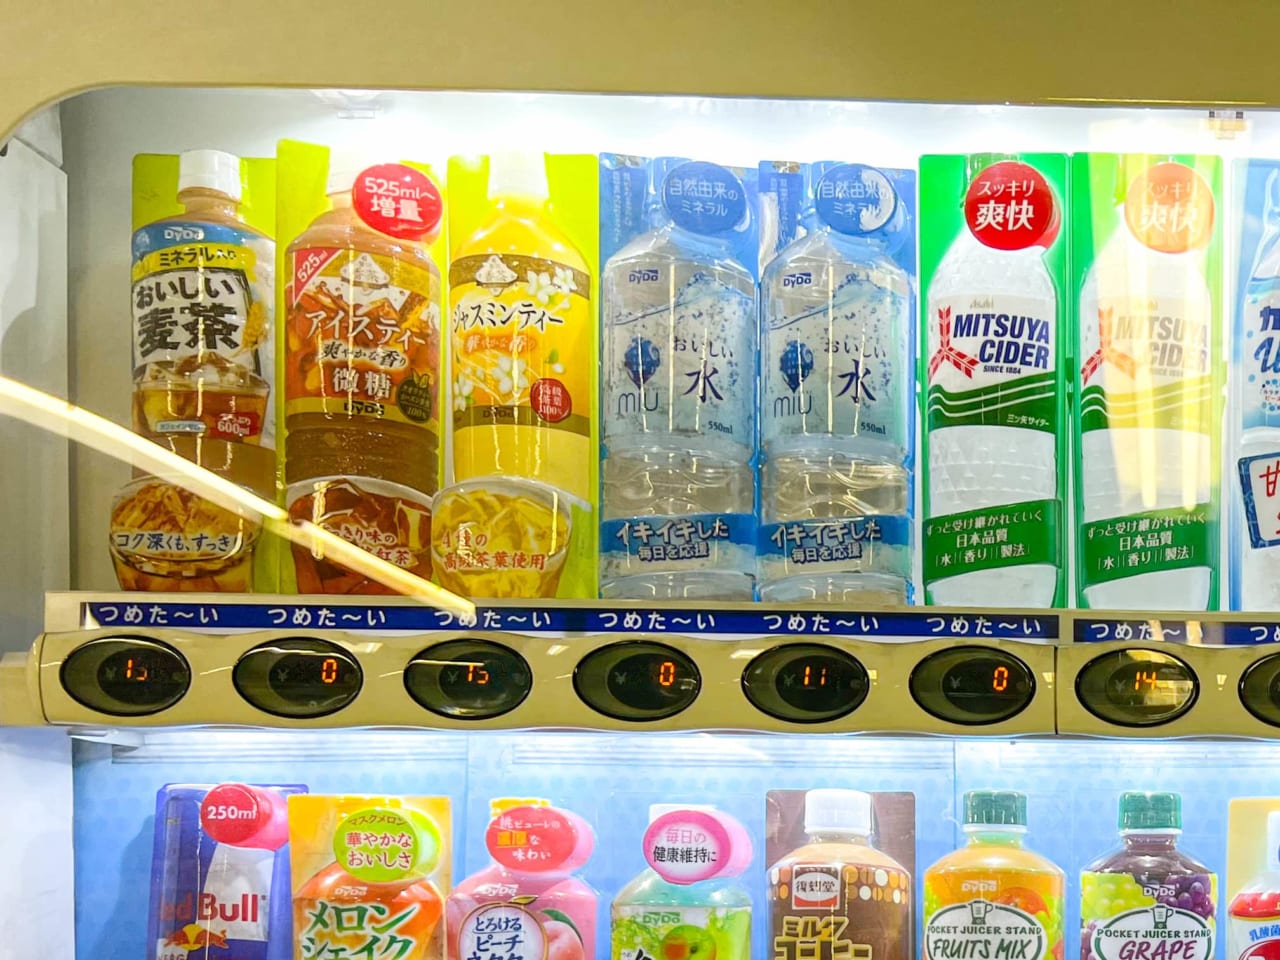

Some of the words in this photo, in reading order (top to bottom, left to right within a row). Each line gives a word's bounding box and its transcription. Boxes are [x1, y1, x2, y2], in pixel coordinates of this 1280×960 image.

[669, 178, 738, 202] 自然由来の
[978, 180, 1035, 196] スッキリ
[681, 203, 728, 217] ミネラル
[975, 202, 1035, 232] 爽快
[628, 269, 658, 285] DyDo
[136, 275, 235, 306] おいしい
[137, 304, 240, 357] 麦茶
[305, 310, 426, 349] アイスティー
[954, 313, 1049, 344] MITSUYA
[979, 340, 1049, 369] CIDER
[684, 359, 724, 403] 水
[708, 421, 733, 435] 550ml
[616, 518, 729, 546] イキイキした
[956, 528, 1008, 548] 日本品質
[599, 612, 715, 630] つめた〜い
[346, 832, 411, 847] 華やかな
[665, 828, 707, 845] 毎日の
[347, 851, 412, 869] おいしさ
[512, 848, 552, 860] 味わい
[653, 846, 717, 864] 健康維持に
[308, 902, 418, 934] メロン
[475, 918, 522, 934] とろける
[927, 926, 958, 936] POCKET
[961, 926, 1001, 936] JUICER
[1005, 926, 1042, 936] STAND
[1097, 929, 1140, 938] POCKET
[1142, 930, 1180, 938] JUICER
[1184, 929, 1211, 938] STAND
[476, 936, 524, 954] ピーチ
[933, 938, 993, 960] FRUITS
[995, 938, 1033, 960] MIX
